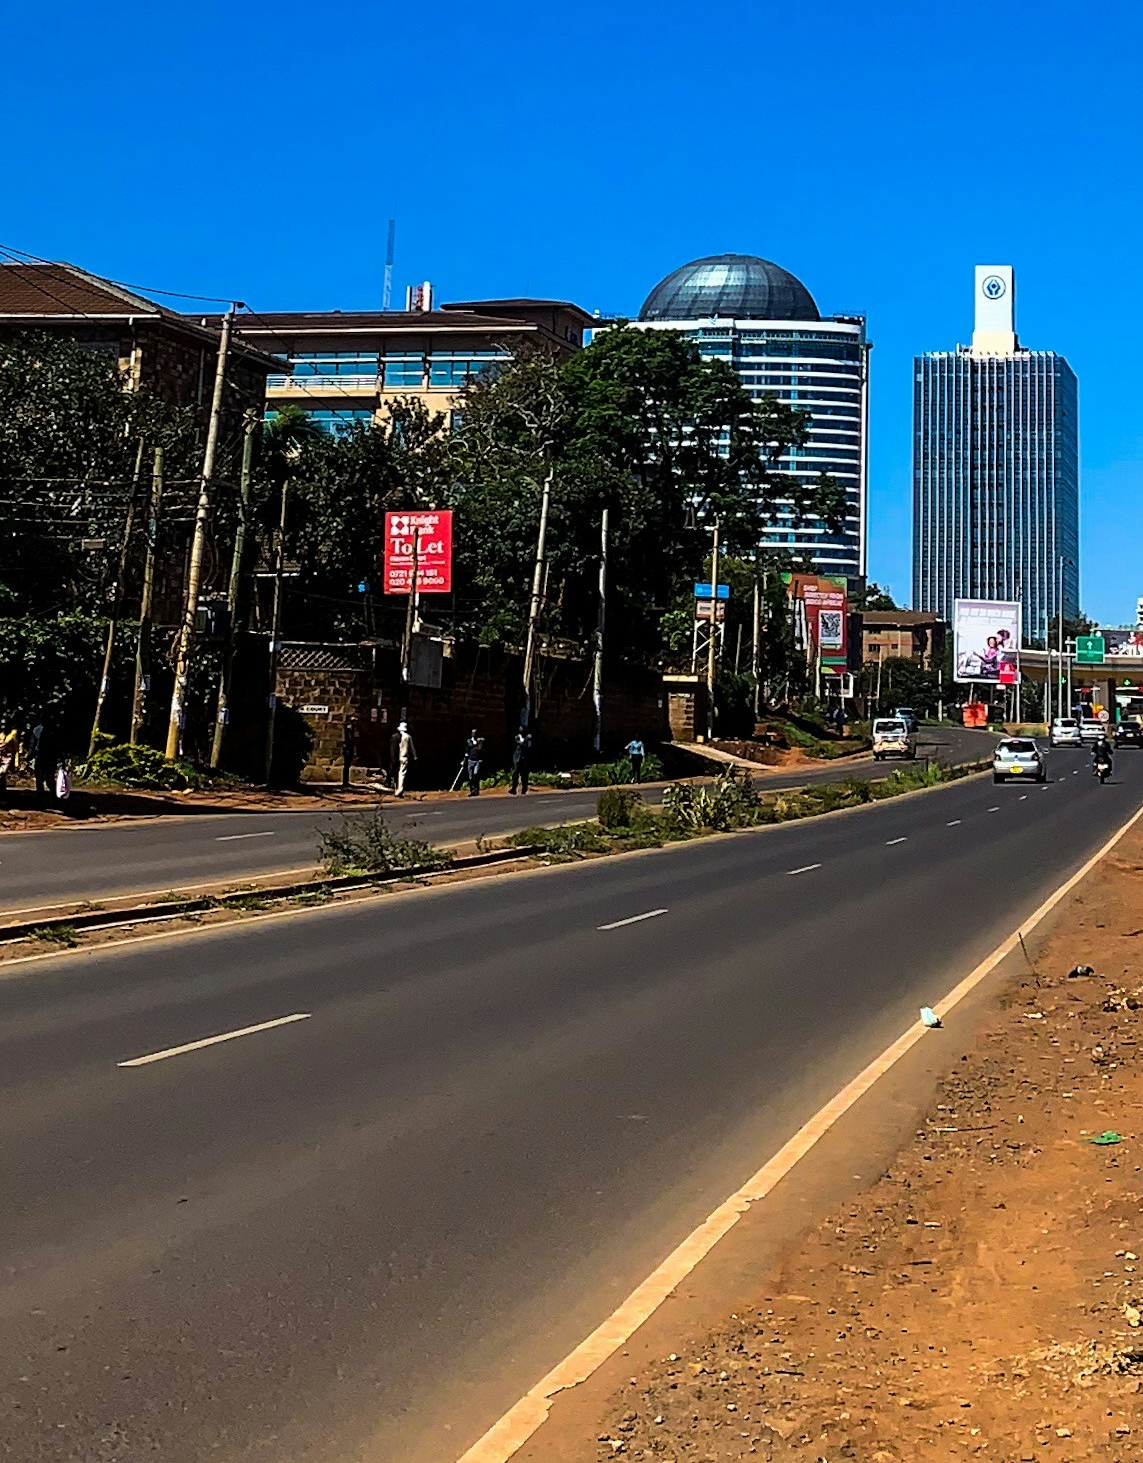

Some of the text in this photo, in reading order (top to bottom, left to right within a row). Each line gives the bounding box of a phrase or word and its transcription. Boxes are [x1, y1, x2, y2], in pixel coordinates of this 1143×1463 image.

[410, 525, 434, 535] Fank
[390, 537, 444, 555] To Let
